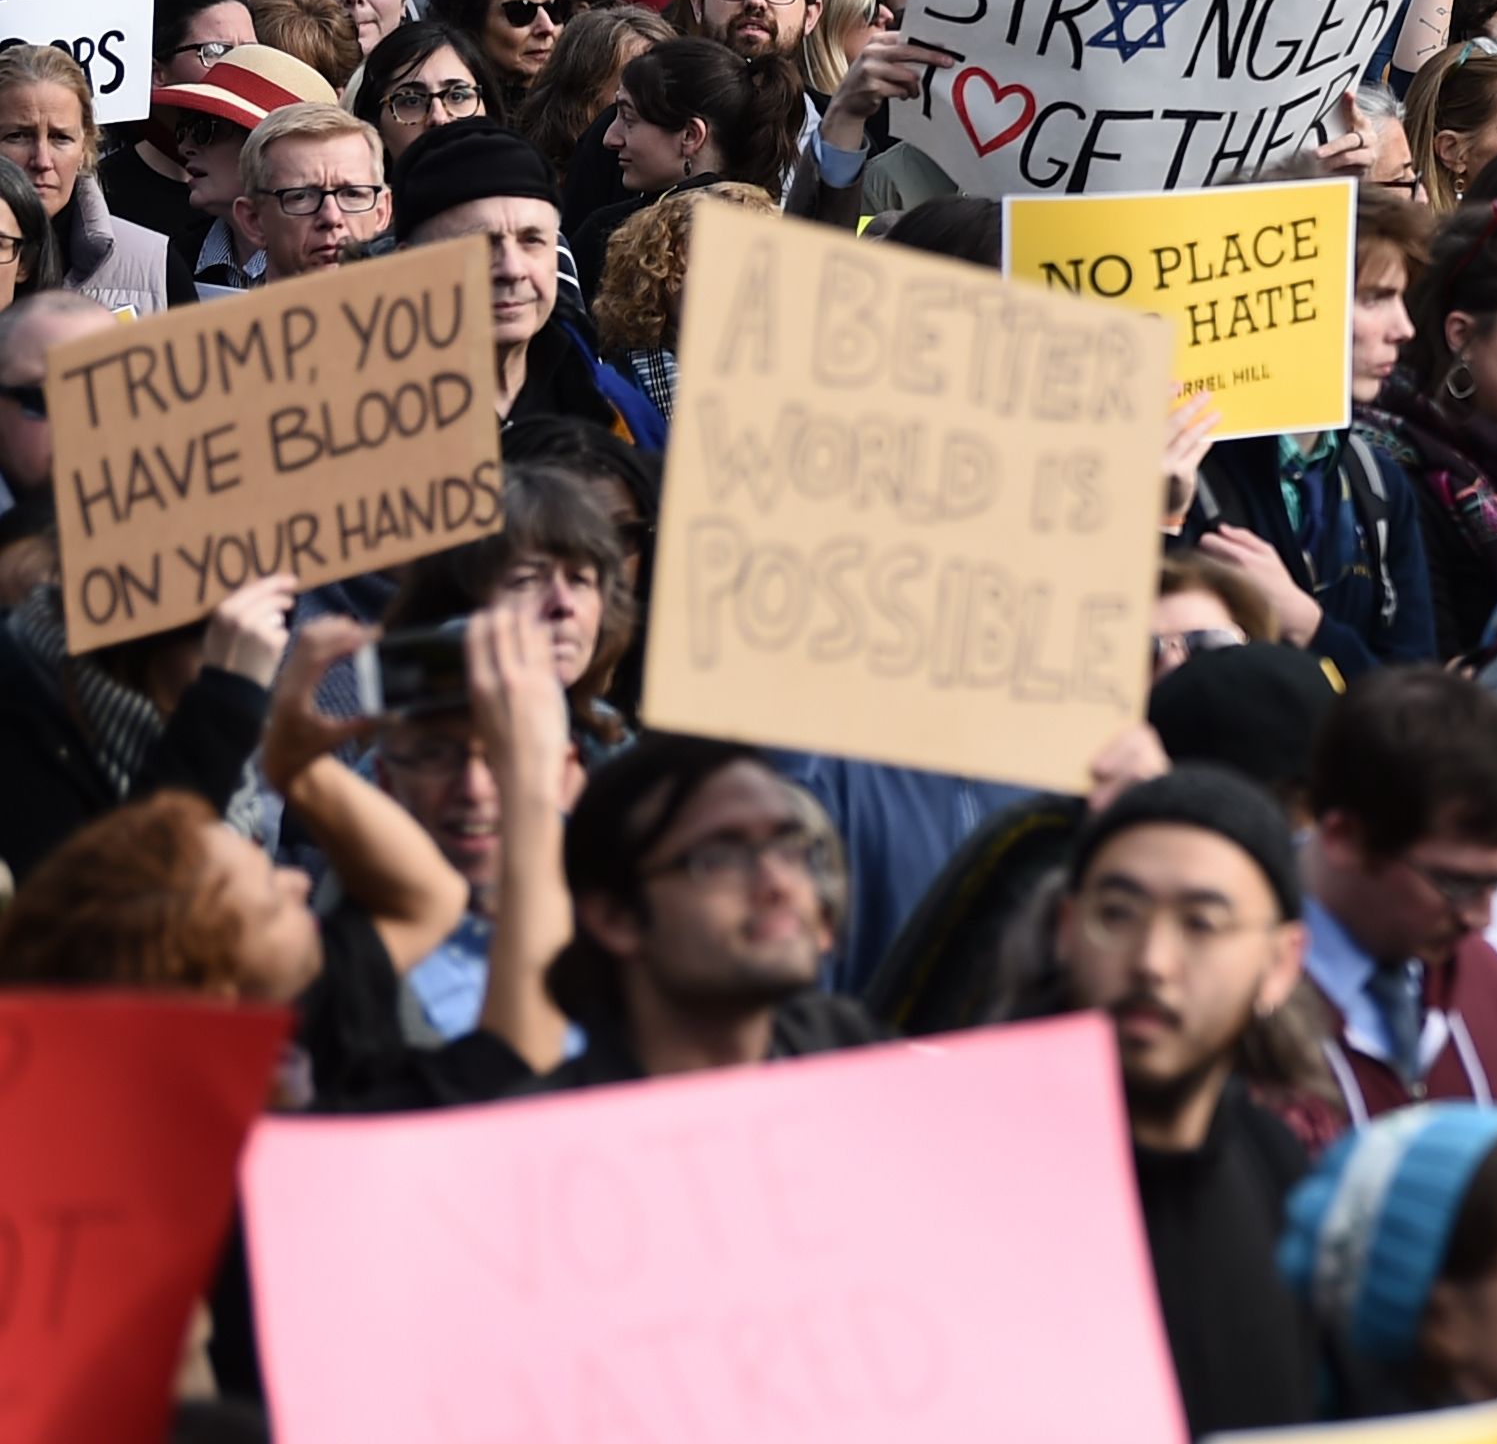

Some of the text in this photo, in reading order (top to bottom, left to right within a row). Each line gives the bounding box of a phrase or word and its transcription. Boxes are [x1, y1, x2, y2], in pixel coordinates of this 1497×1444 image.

[714, 238, 1148, 424] A BETTER
[1040, 217, 1319, 300] NO PLACE
[1187, 280, 1318, 349] HATE
[62, 283, 463, 428] TRUMP, YOU
[1232, 364, 1270, 389] HILL
[73, 370, 473, 539] HAVE BLOOD
[695, 391, 1111, 535] WORLD IS
[81, 460, 500, 627] ON YOUR HANDS
[686, 515, 1132, 708] POSSIBLE
[421, 1113, 848, 1304] VOTE
